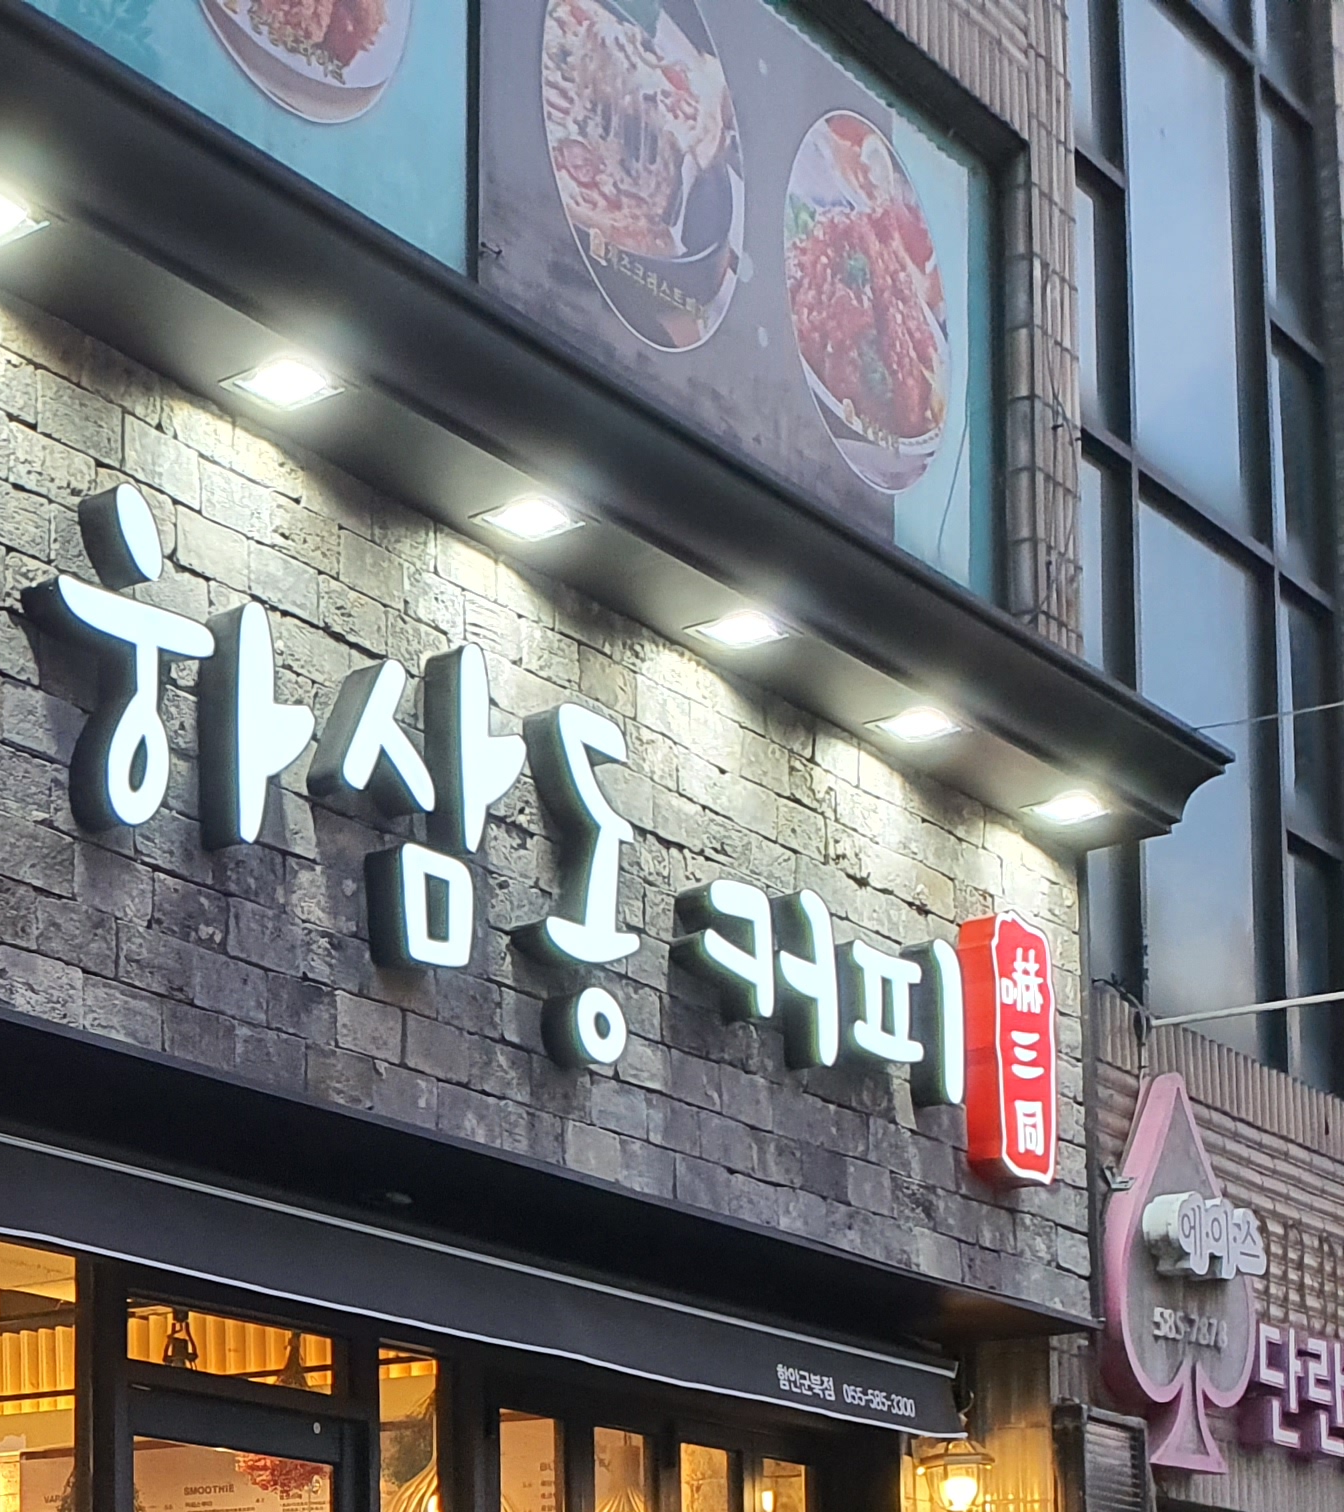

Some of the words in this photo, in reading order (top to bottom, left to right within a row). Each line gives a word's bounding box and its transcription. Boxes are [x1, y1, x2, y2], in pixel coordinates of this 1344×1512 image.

[57, 482, 641, 1064] 하삼동
[703, 878, 963, 1104] 커피
[1153, 1307, 1229, 1349] 585-7878
[776, 1363, 835, 1400] 함안군북점
[842, 1384, 916, 1418] 055-585-3300
[184, 1484, 235, 1496] SMOOTHIE
